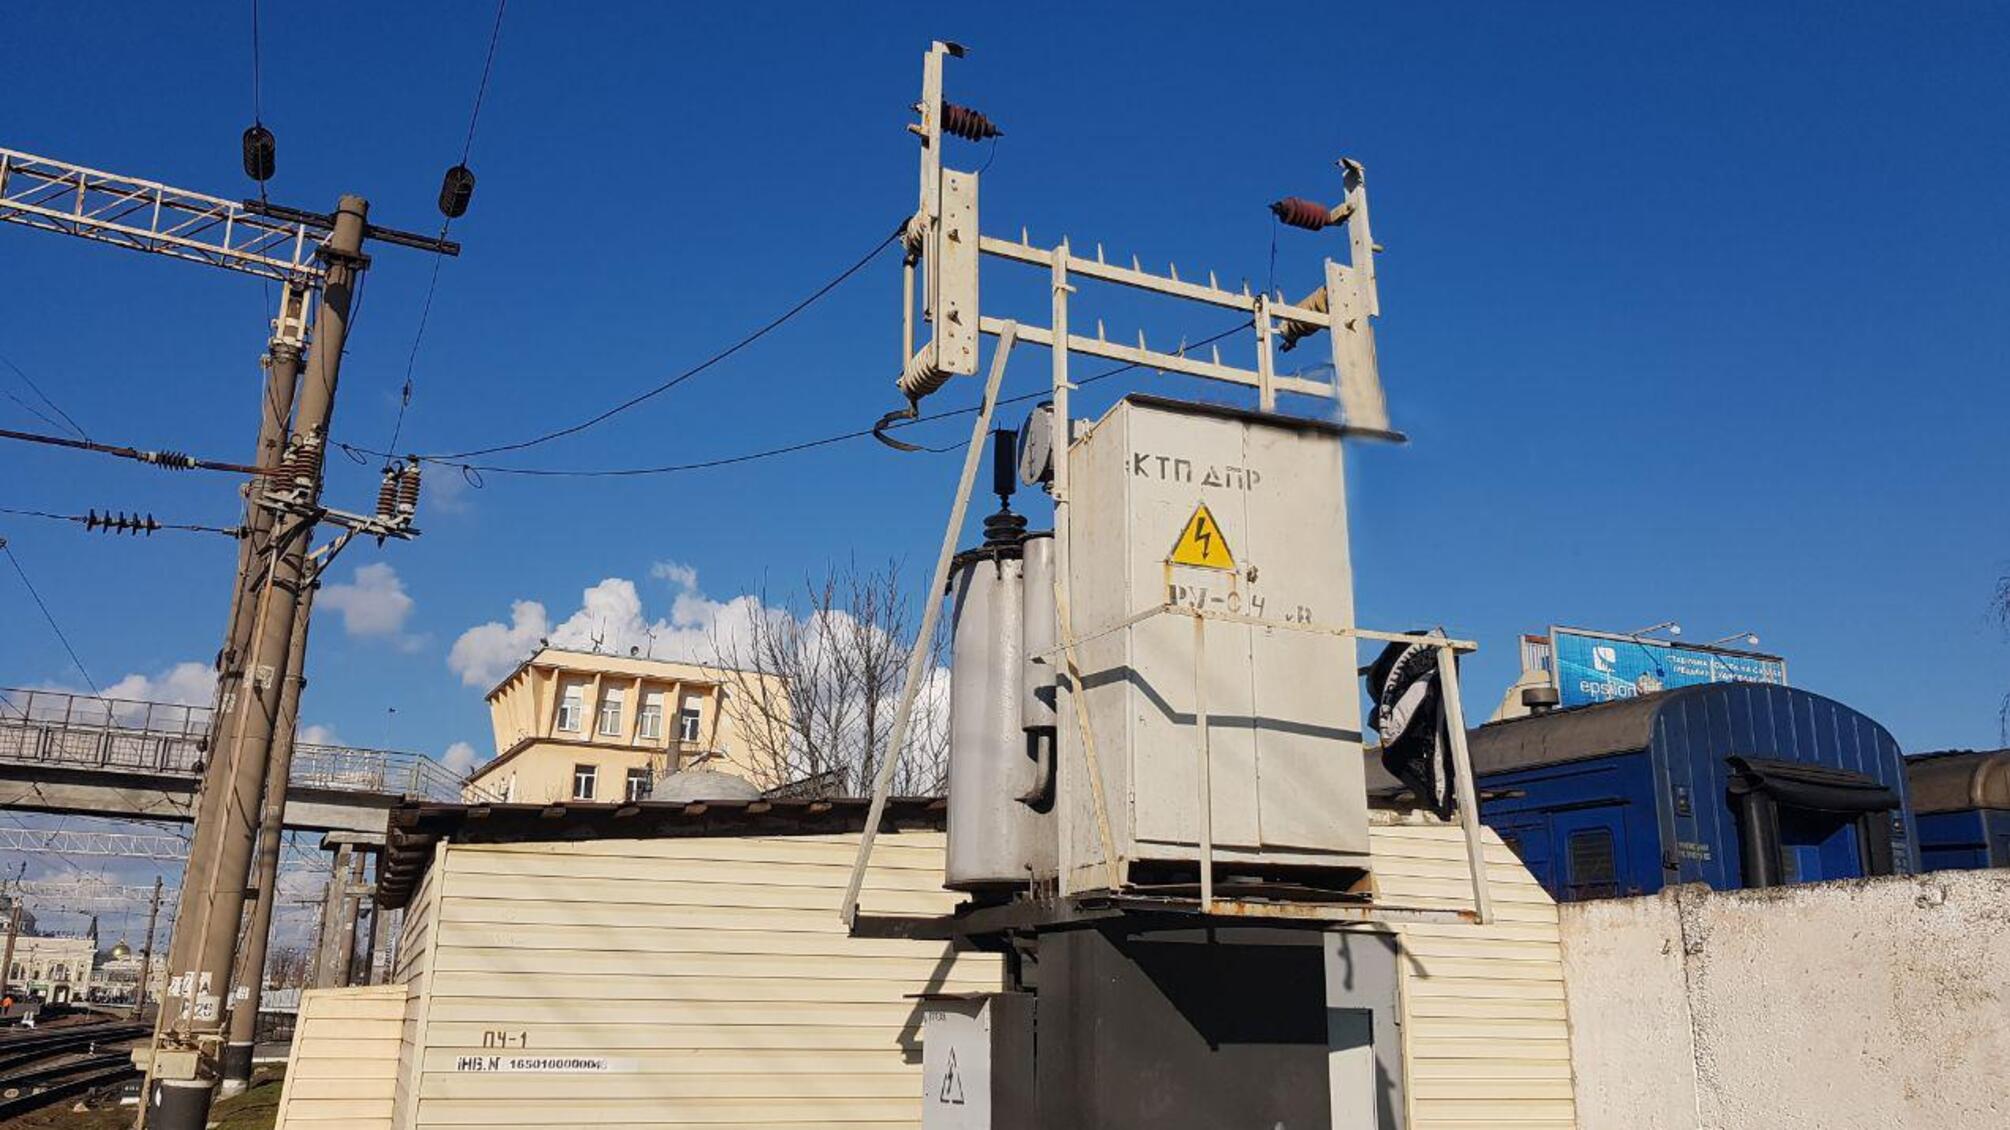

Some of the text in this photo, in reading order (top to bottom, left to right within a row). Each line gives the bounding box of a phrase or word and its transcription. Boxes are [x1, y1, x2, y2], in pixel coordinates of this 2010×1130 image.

[1134, 452, 1261, 491] КТП ДПР
[1580, 680, 1637, 698] epsilon
[483, 1031, 527, 1048] ПЧ-1
